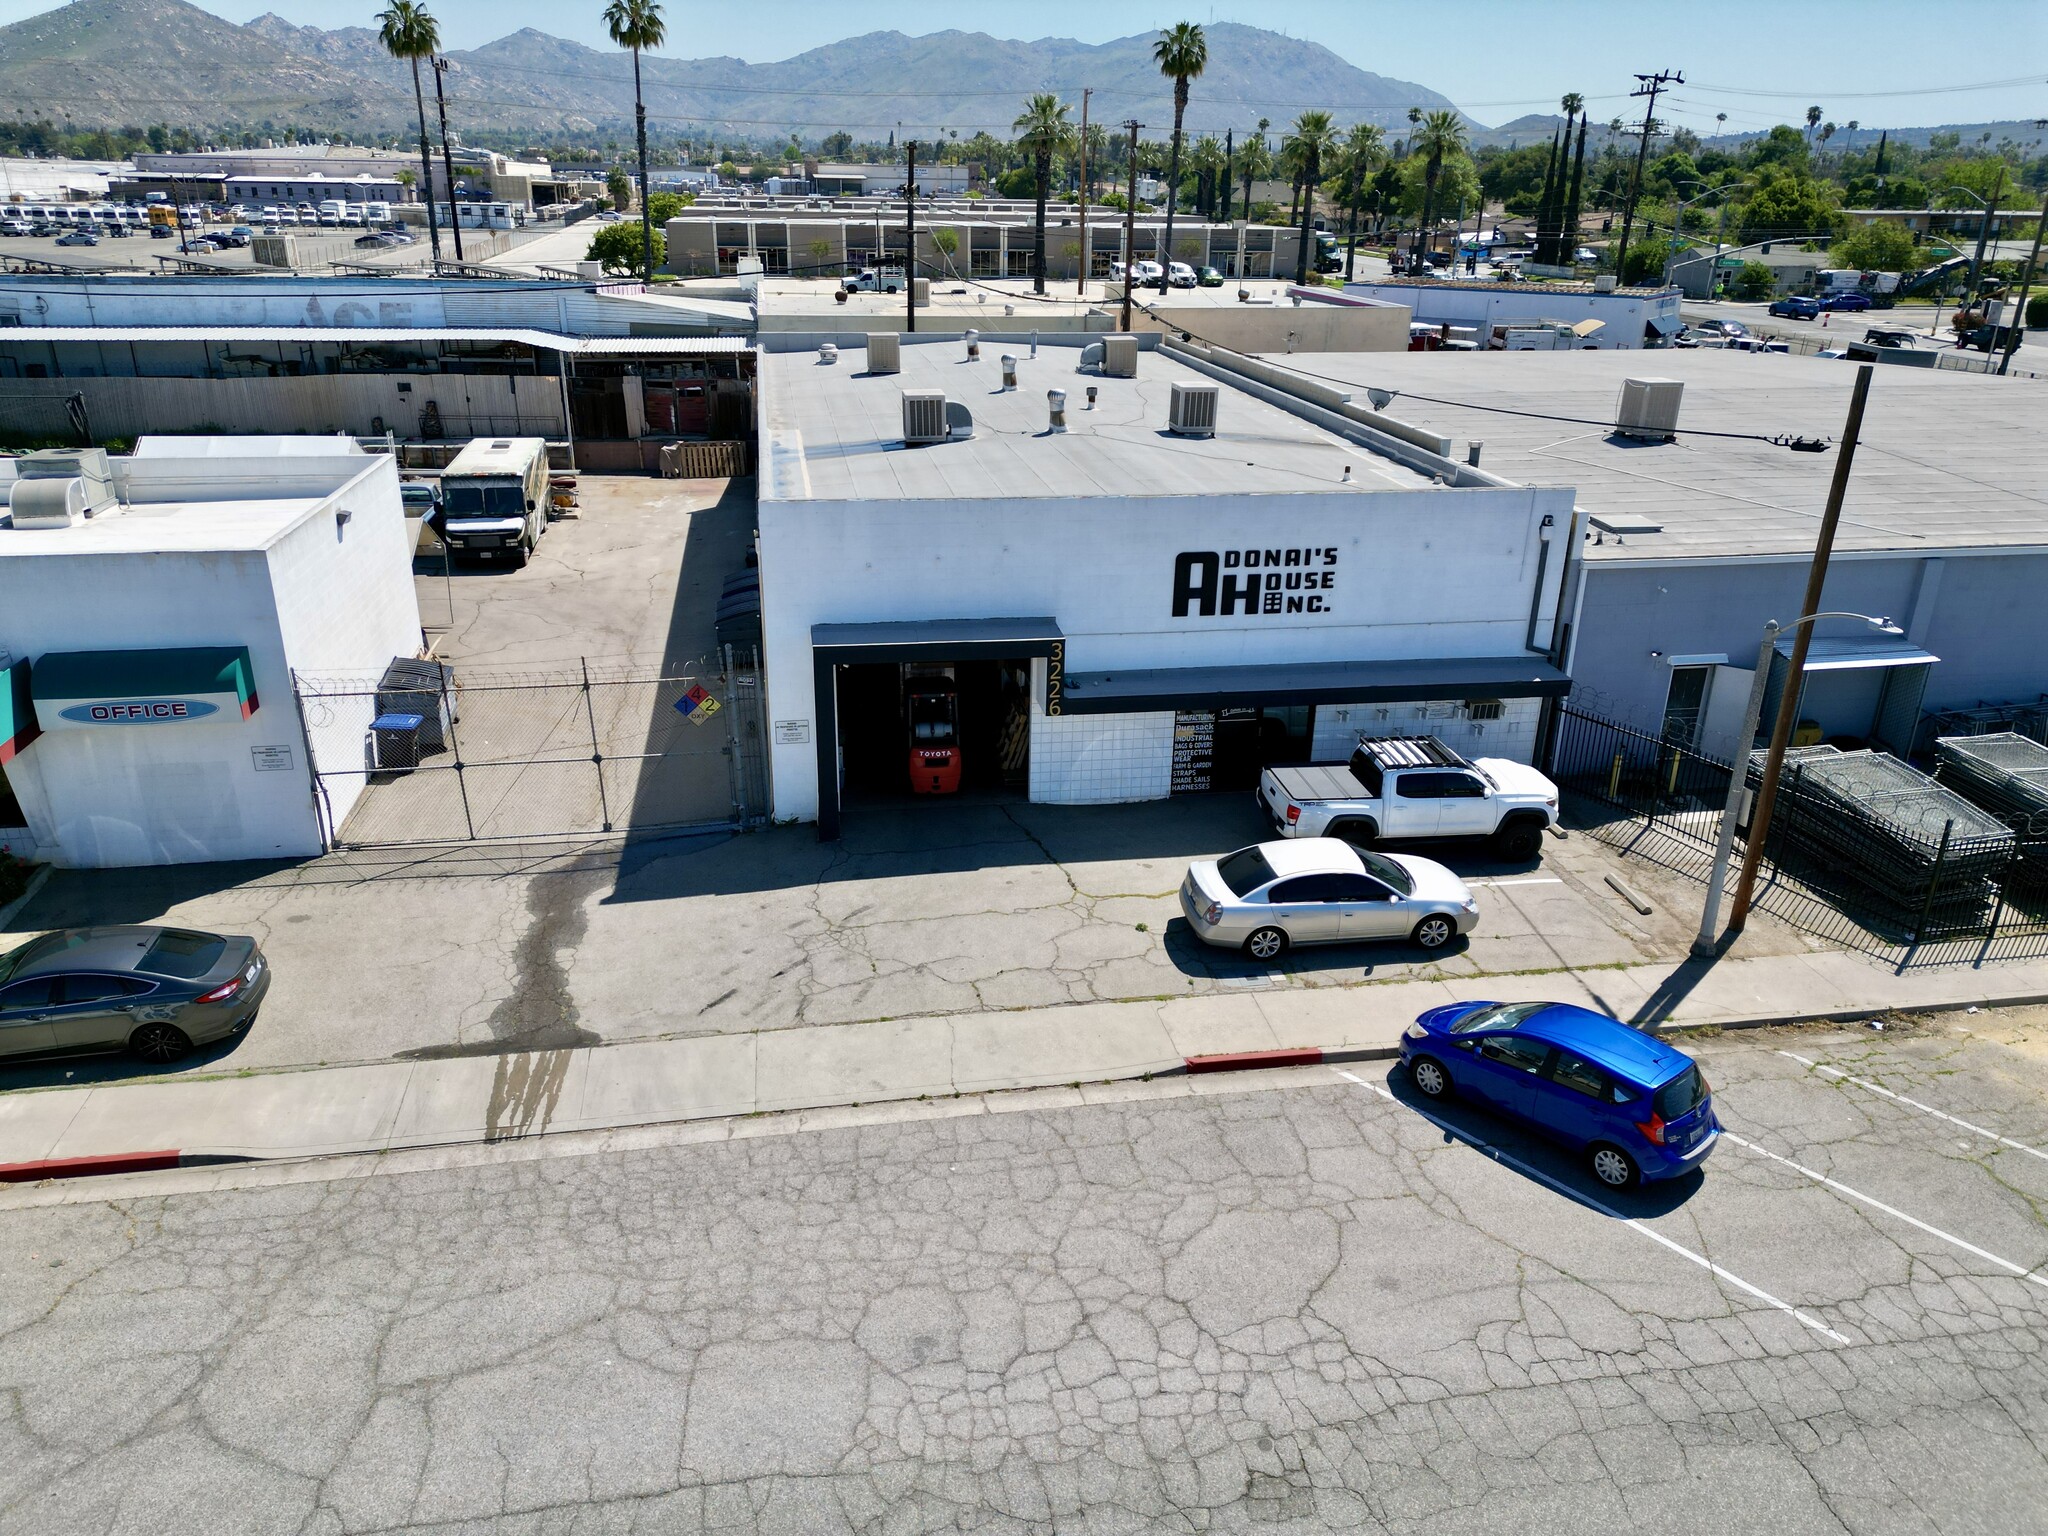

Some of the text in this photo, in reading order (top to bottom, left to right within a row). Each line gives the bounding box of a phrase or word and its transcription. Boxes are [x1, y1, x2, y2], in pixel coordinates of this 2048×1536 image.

[1049, 642, 1063, 716] 3226
[691, 688, 701, 699] 4
[681, 698, 715, 713] 1 2
[90, 702, 188, 720] OFFICE
[1176, 713, 1215, 722] MANUFACTURING
[1176, 723, 1214, 731] Durasack
[1175, 734, 1213, 742] INDUSTRIAL
[1172, 783, 1210, 791] HARNESSES
